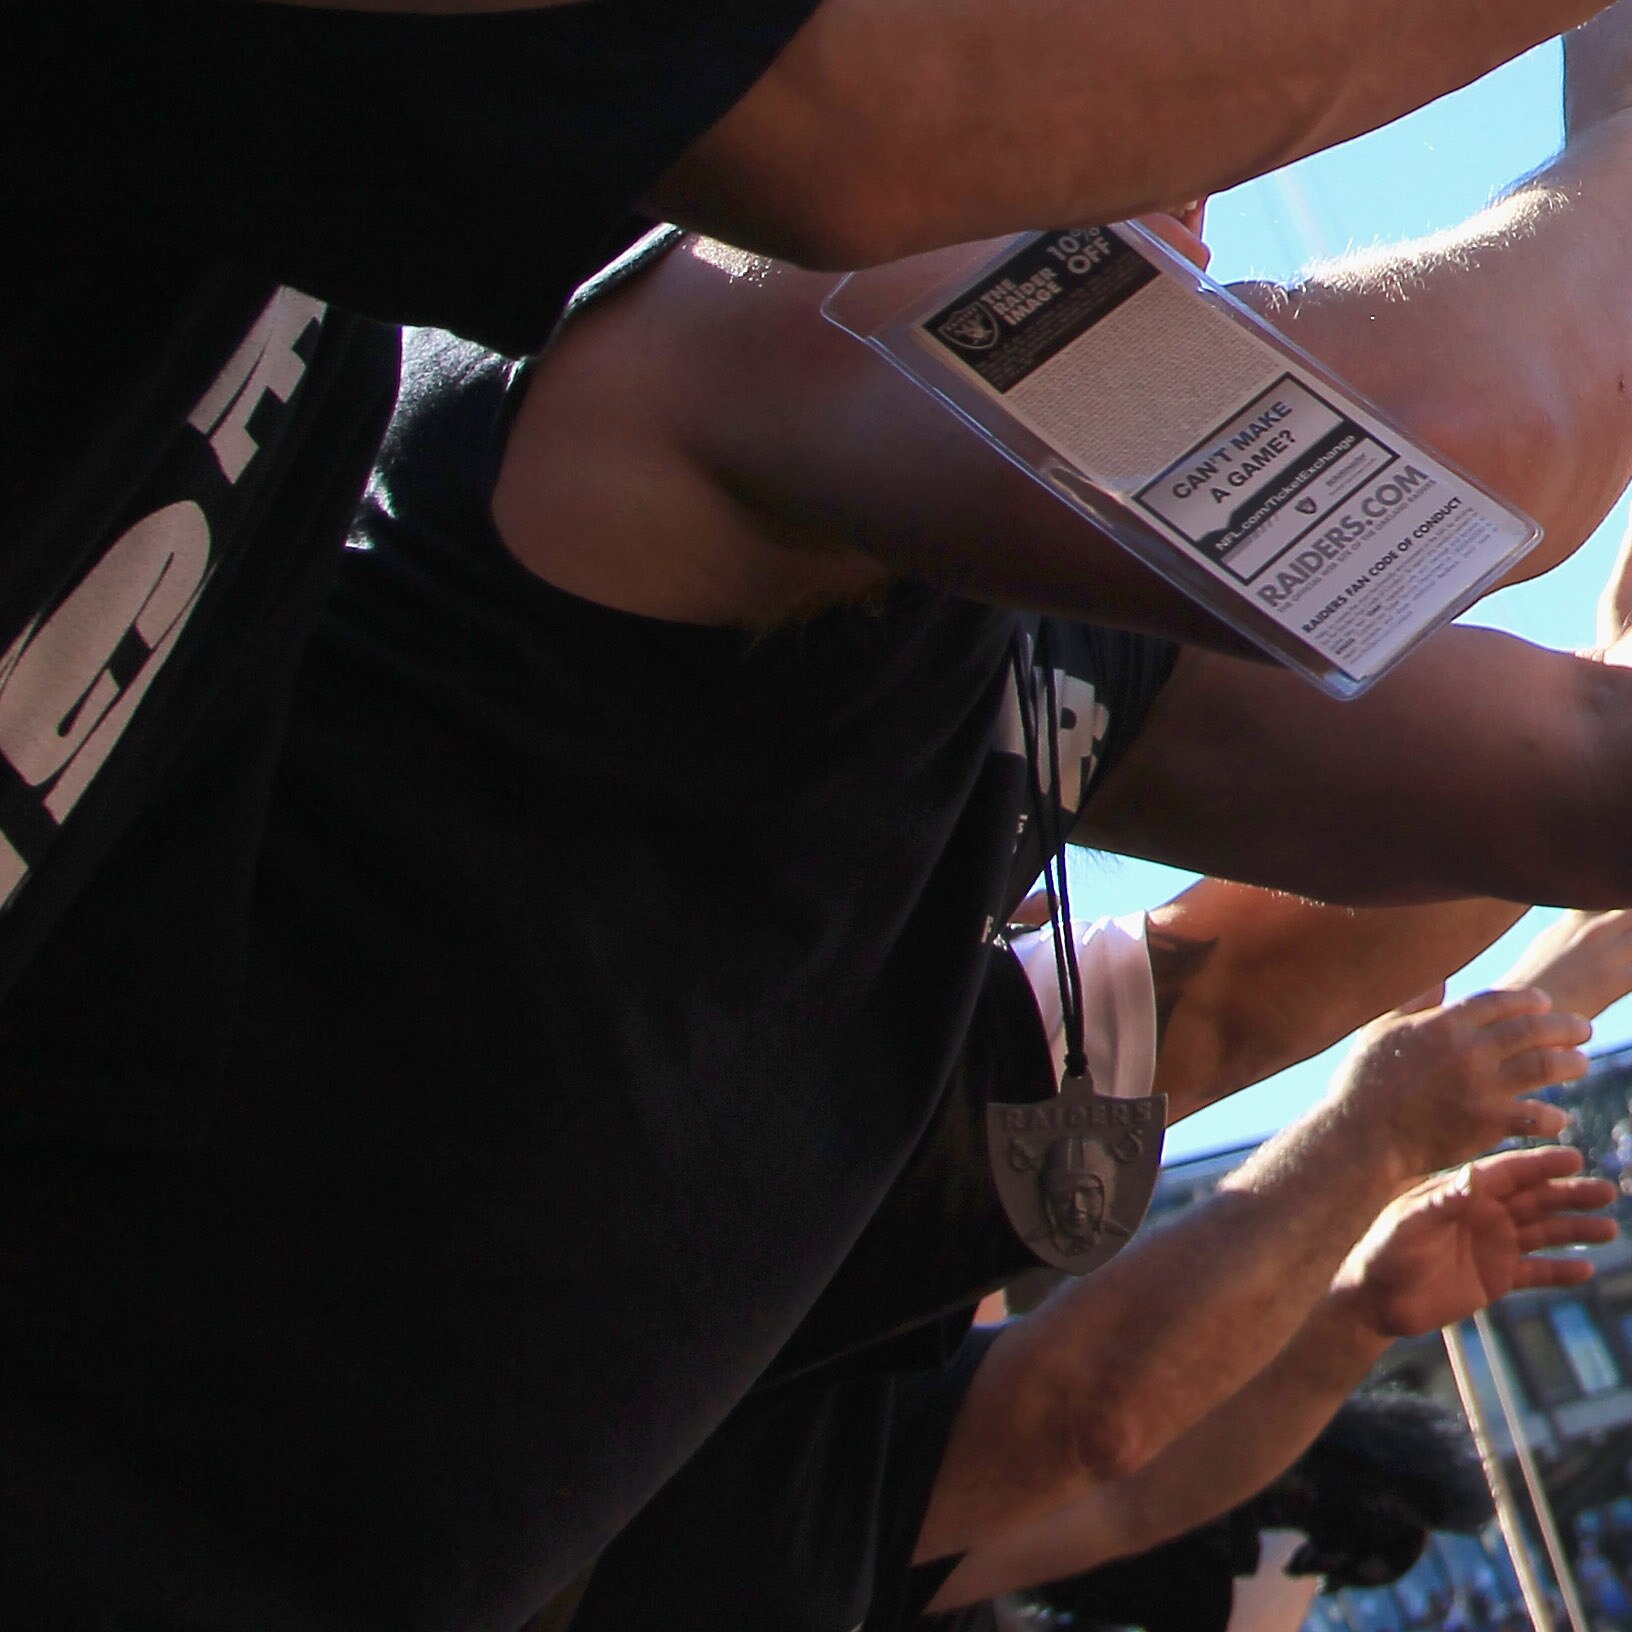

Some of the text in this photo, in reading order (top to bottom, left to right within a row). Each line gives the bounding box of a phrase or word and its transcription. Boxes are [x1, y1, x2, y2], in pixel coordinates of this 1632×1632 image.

[1066, 236, 1112, 275] OFF
[980, 277, 1016, 305] THE
[992, 267, 1057, 316] RAIDER
[1003, 282, 1062, 325] IMAGE
[1171, 401, 1293, 499] CAN'T MAKE
[1210, 486, 1230, 504] A
[1227, 429, 1296, 487] GAME?
[1215, 435, 1355, 551] NFL.com/TicketExchange
[1256, 465, 1429, 607] RAIDERS.COM
[1302, 496, 1463, 634] RAIDERS FAN CODE OF CONDUCT
[1005, 1102, 1153, 1131] RAIDERS
